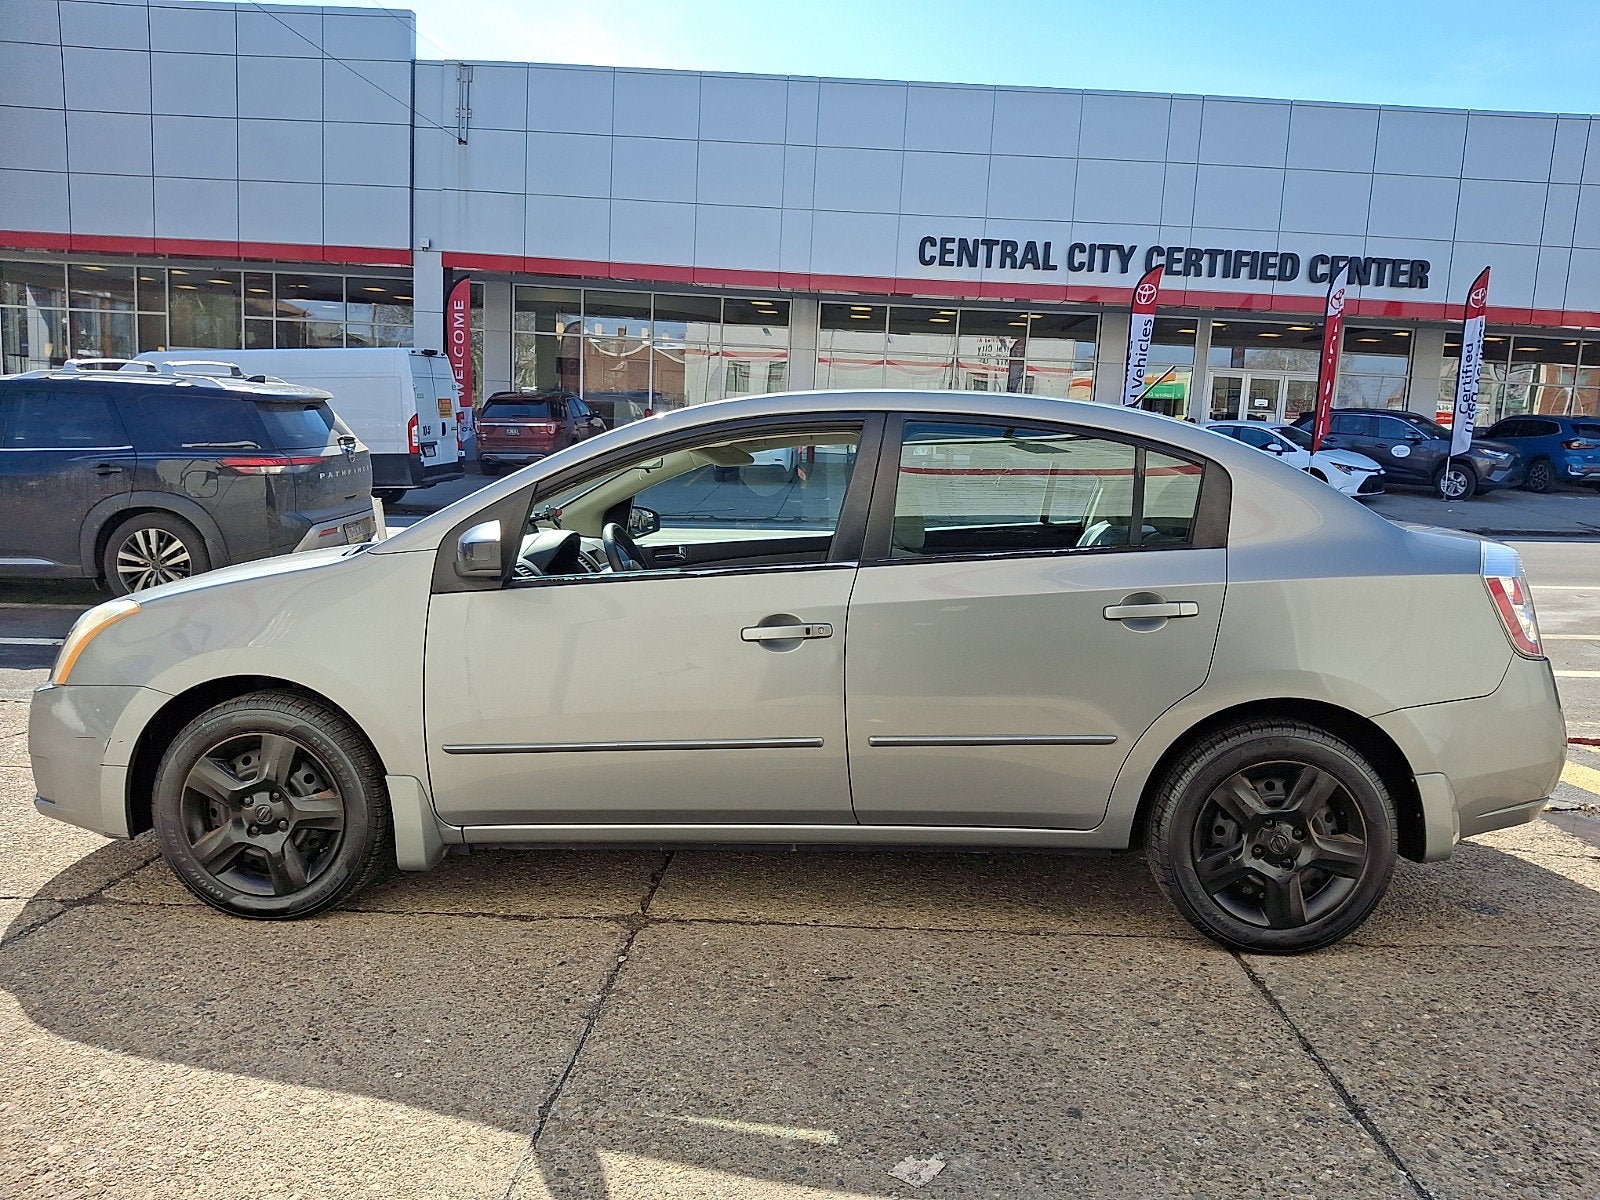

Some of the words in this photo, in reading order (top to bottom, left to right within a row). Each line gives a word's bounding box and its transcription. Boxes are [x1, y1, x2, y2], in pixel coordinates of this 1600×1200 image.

[918, 235, 1058, 271] CENTRAL
[1067, 242, 1138, 274] CITY
[1145, 245, 1300, 283] CERTIFIED
[1309, 253, 1431, 289] CENTER
[453, 299, 465, 398] WELCOME
[1131, 318, 1153, 390] Vehicles
[1459, 343, 1474, 415] Certified
